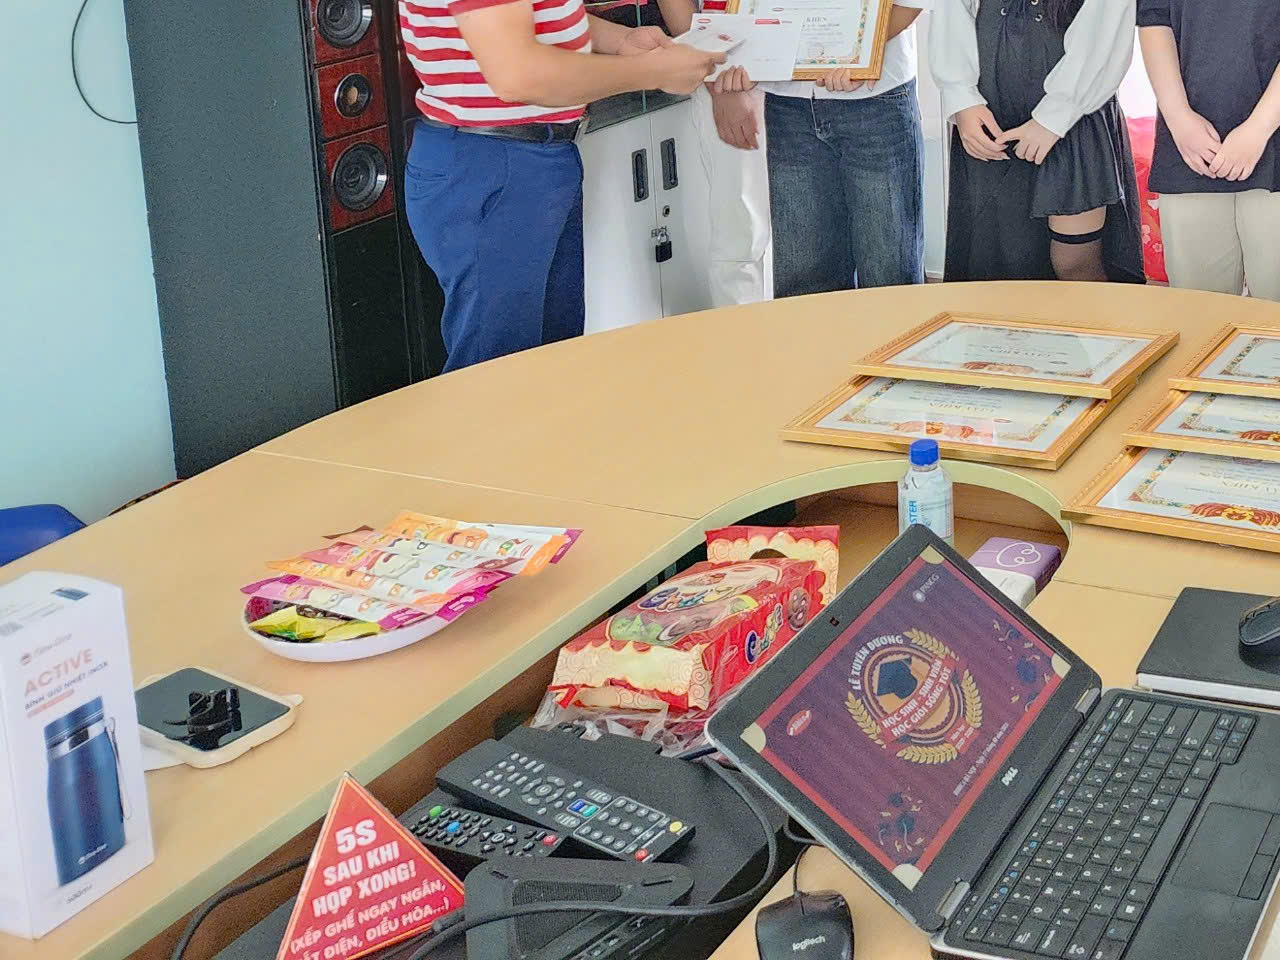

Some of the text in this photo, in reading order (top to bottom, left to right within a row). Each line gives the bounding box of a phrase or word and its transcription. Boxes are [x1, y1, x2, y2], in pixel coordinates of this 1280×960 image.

[25, 648, 93, 696] ACTIVE
[851, 646, 870, 676] TUYÊN
[867, 634, 904, 651] DƯƠNG
[891, 720, 912, 737] HỌC
[926, 684, 944, 709] SỐNG
[900, 699, 919, 717] SINH
[919, 677, 932, 698] SINH
[931, 659, 943, 678] VIÊN
[1001, 766, 1019, 786] DELL
[335, 819, 377, 854] 5S
[323, 841, 400, 886] SAU KHI
[312, 859, 417, 917] HỌP XONG!
[358, 897, 398, 924] NGAY
